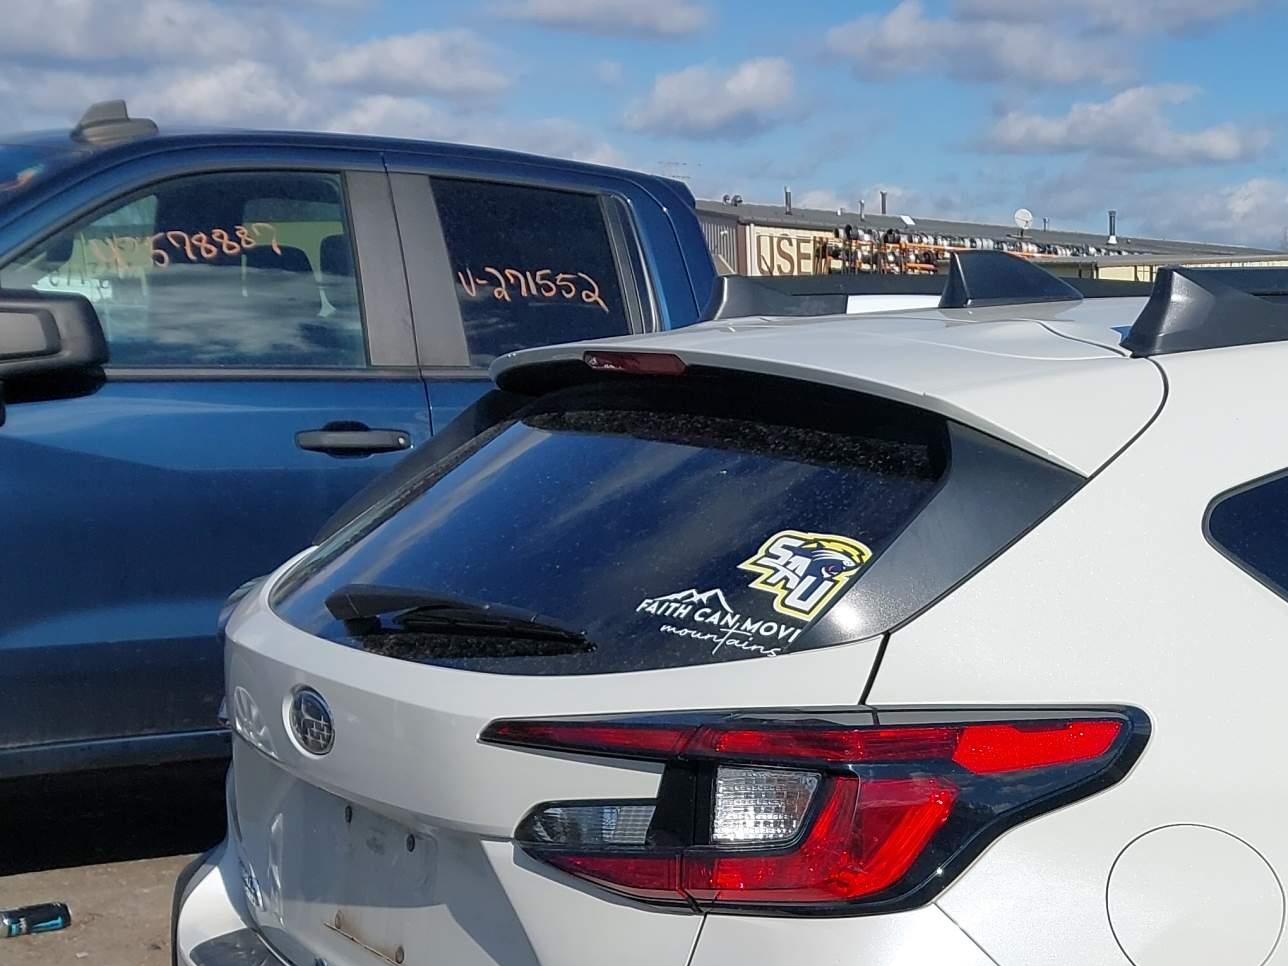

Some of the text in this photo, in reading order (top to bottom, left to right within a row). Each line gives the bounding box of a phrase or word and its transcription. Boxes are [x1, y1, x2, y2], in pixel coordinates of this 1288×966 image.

[636, 599, 693, 618] FAITH
[694, 607, 741, 628] CAN
[659, 622, 781, 657] mountains
